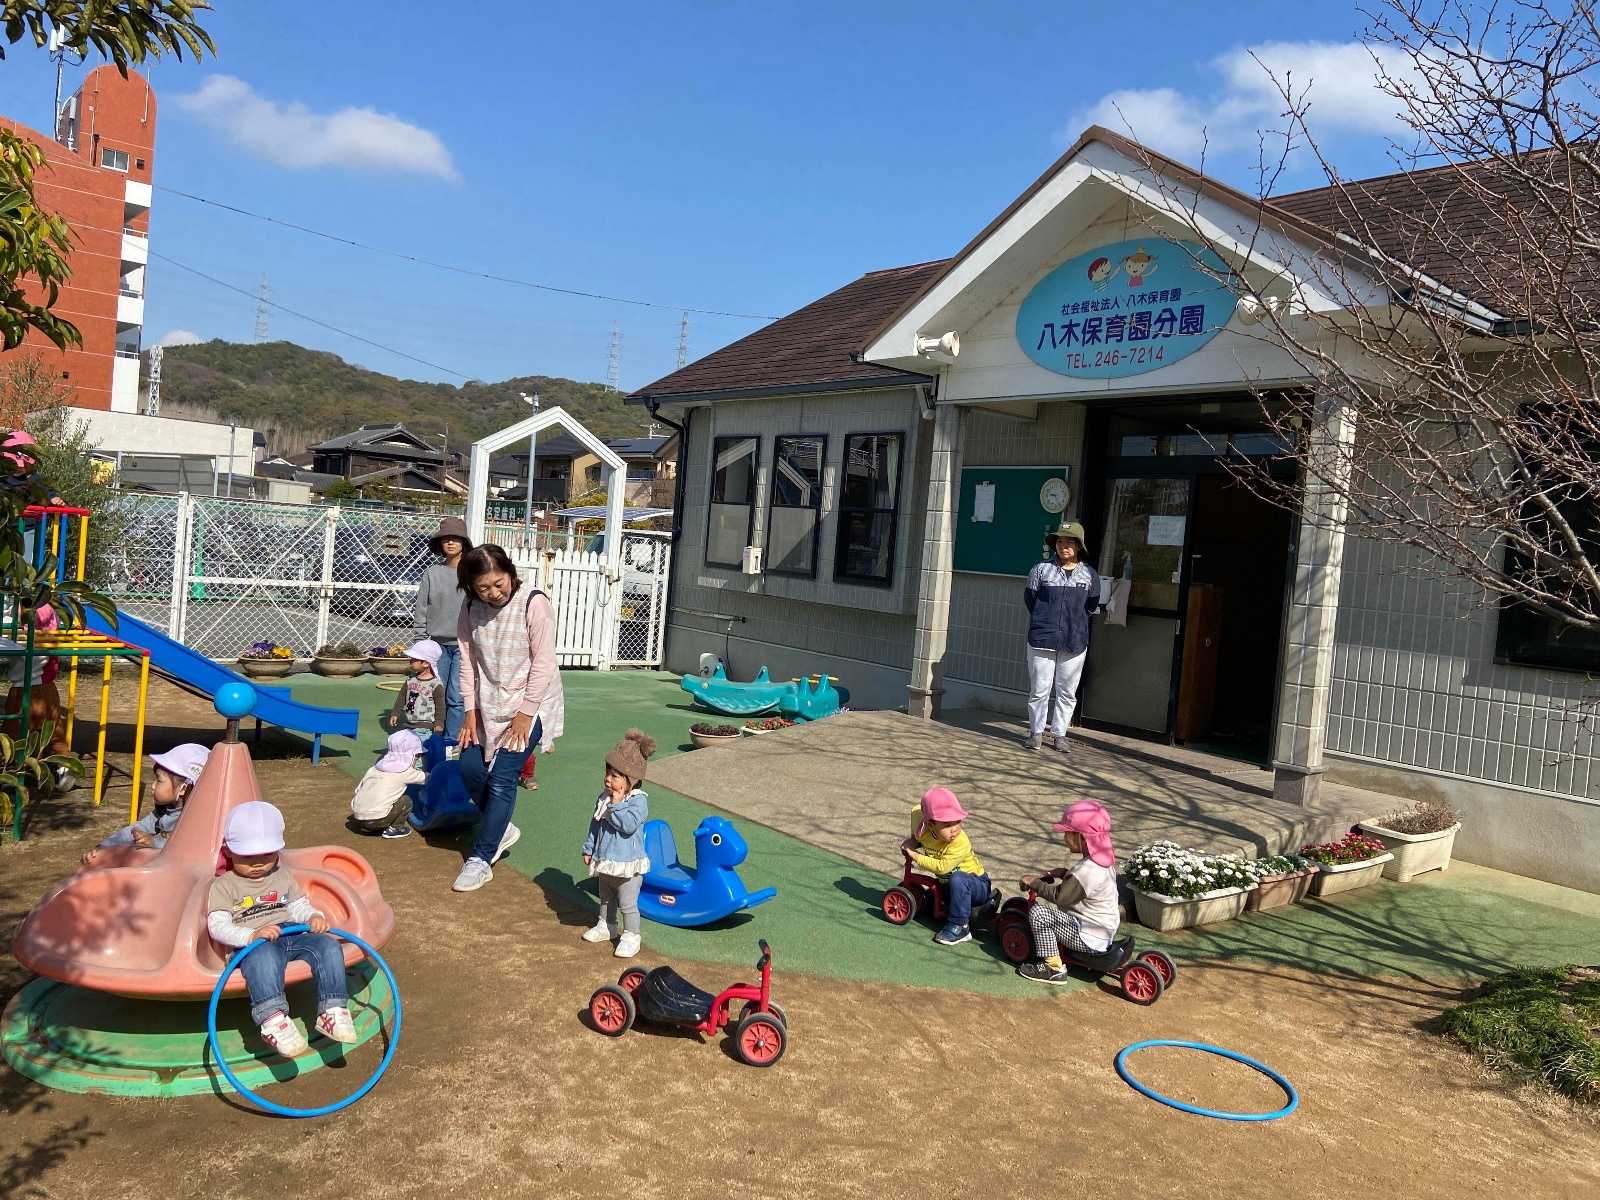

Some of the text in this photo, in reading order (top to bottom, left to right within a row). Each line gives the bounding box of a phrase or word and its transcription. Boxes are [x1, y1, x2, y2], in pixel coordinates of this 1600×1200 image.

[1061, 288, 1181, 316] 社会福祉法人 八木保育園
[1037, 304, 1205, 350] 八木保育園分園
